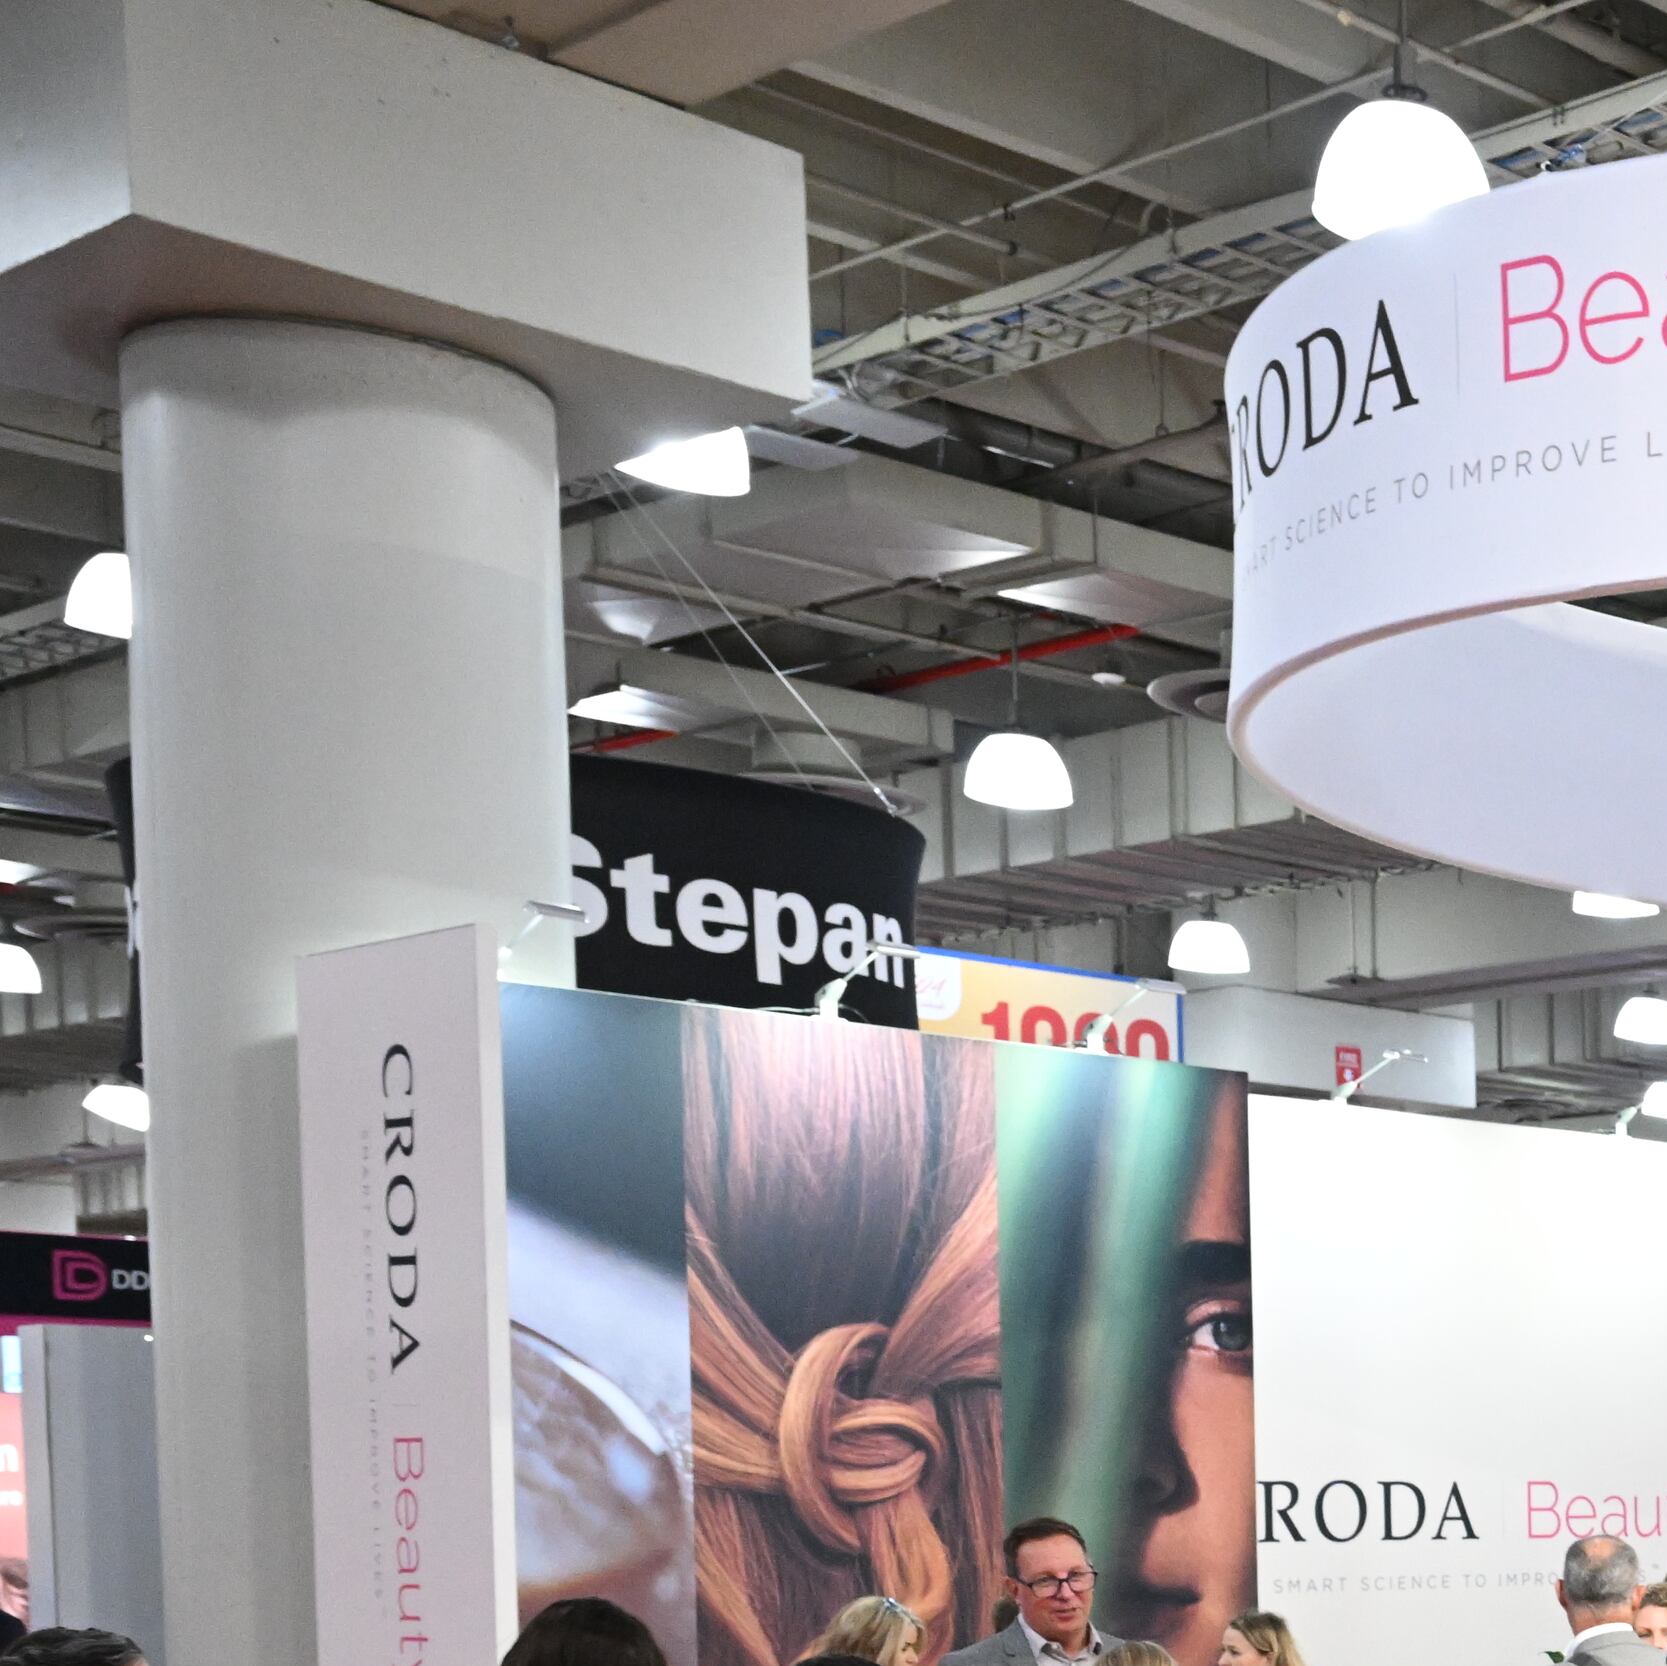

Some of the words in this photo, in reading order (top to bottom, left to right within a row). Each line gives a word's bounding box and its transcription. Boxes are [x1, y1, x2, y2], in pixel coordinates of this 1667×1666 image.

[1231, 299, 1420, 513] RODA
[1284, 486, 1377, 552] SCIENCE
[1393, 477, 1430, 505] TO
[1449, 435, 1618, 490] IMPROVE
[571, 831, 908, 989] Stepan
[381, 1043, 421, 1377] CRODA
[111, 1268, 150, 1290] DD
[1256, 1479, 1480, 1543] RODA
[1273, 1577, 1348, 1595] SMART
[1360, 1574, 1451, 1593] SCIENCE
[1462, 1572, 1488, 1589] TO
[1498, 1570, 1559, 1588] IMPRO
